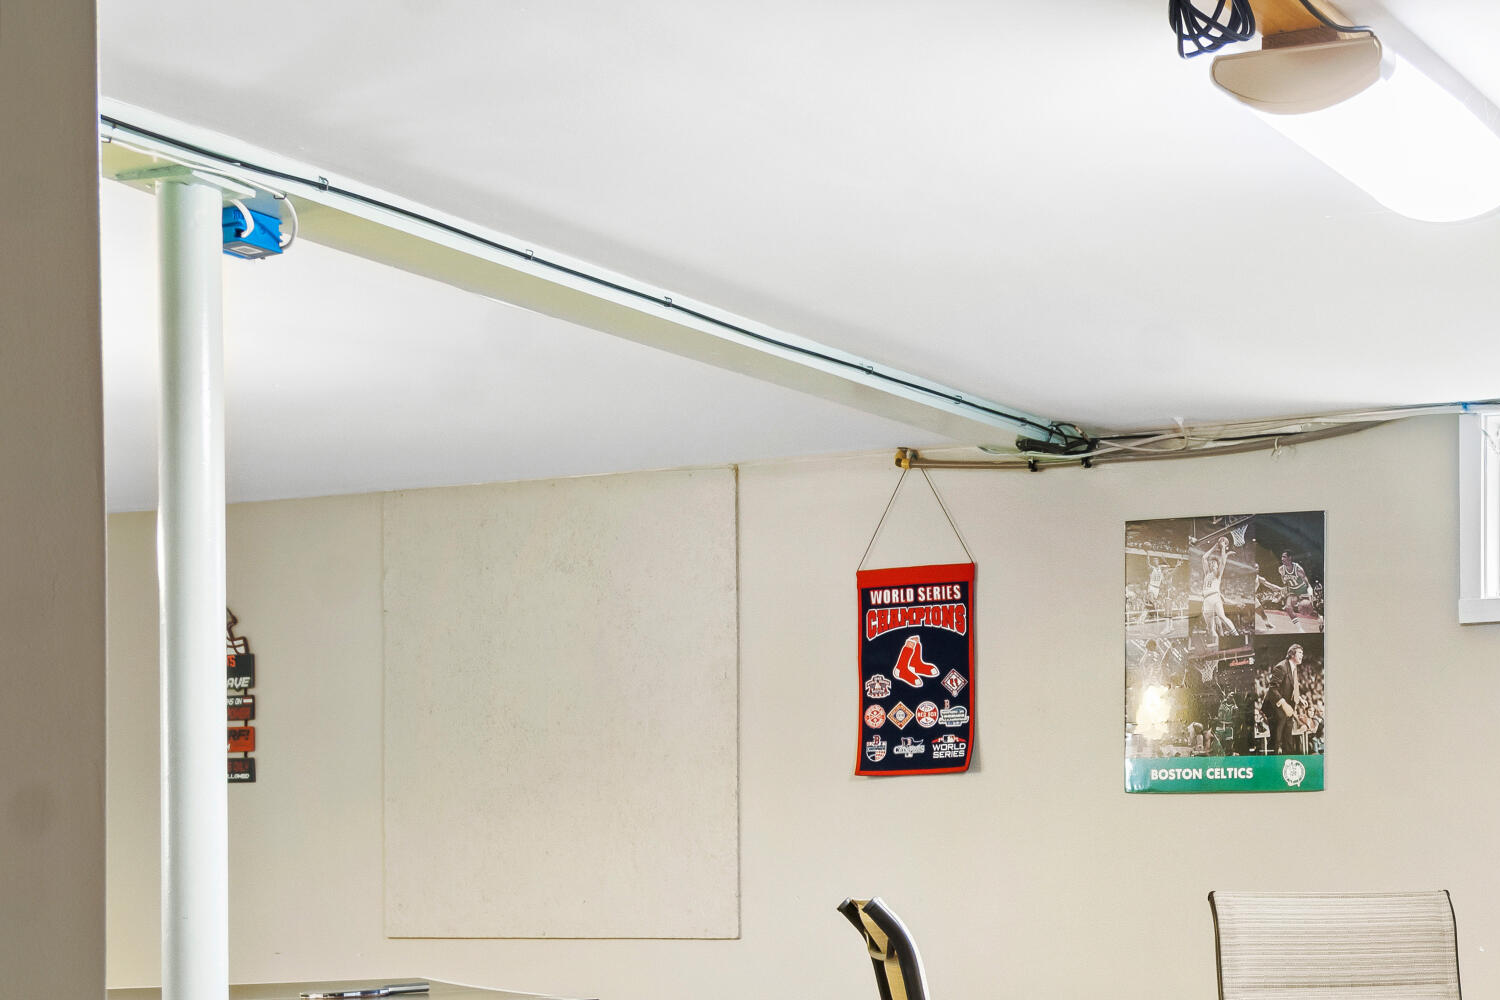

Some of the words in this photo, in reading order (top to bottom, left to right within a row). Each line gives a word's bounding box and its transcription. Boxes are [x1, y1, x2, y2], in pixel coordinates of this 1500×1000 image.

[870, 587, 915, 605] WORLD
[917, 584, 962, 602] SERIES
[866, 603, 967, 641] CHAMPIONS
[227, 676, 251, 689] AVE
[932, 743, 966, 751] WORLD
[932, 750, 965, 759] SERIES
[1151, 768, 1202, 781] BOSTON
[1206, 767, 1254, 780] CELTICS
